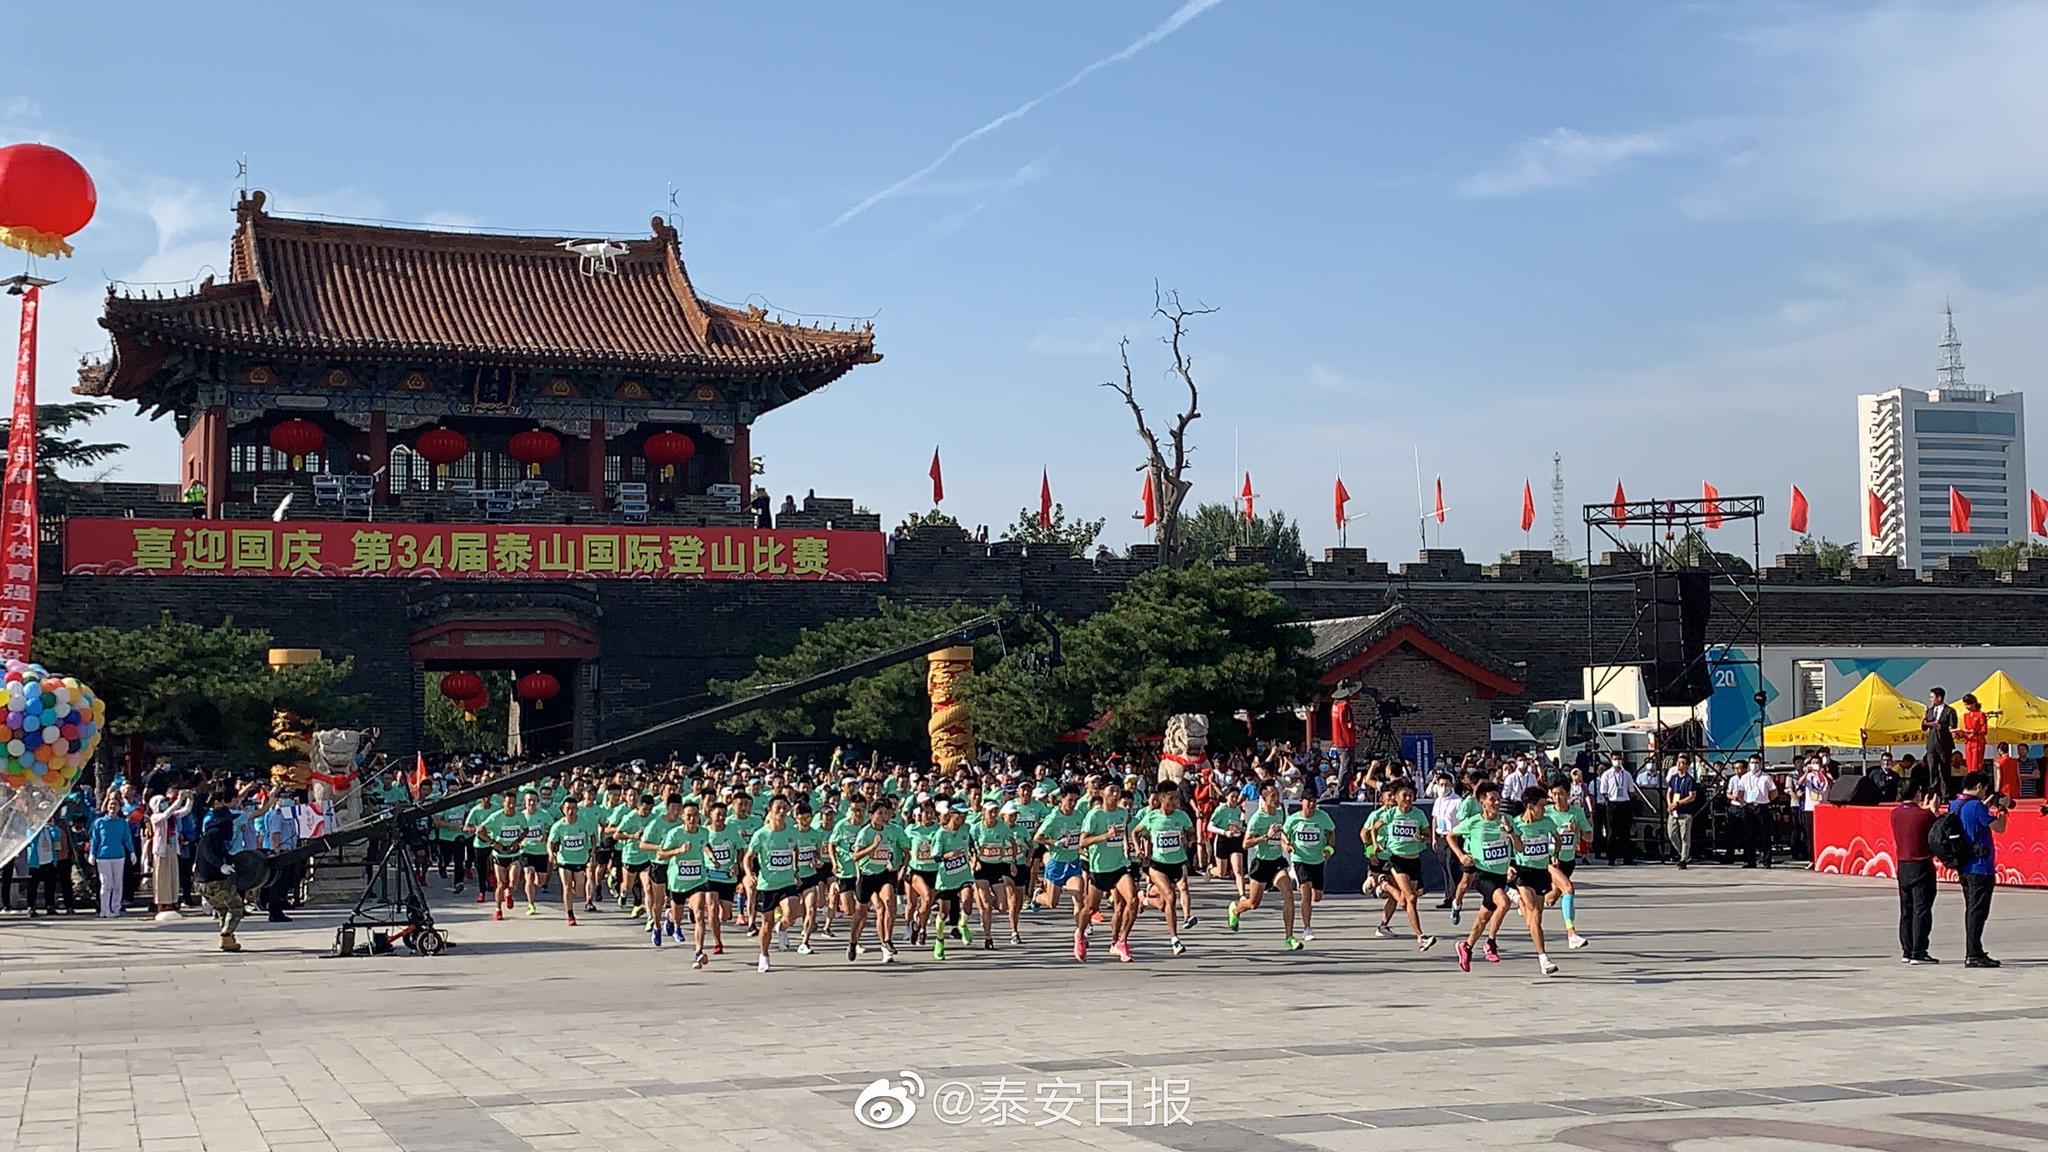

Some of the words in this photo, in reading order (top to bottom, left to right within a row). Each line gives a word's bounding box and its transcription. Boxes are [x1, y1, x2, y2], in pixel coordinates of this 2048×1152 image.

[132, 528, 323, 570] 喜迎国庆
[350, 530, 830, 576] 第34届泰山国际登山比赛
[714, 850, 730, 859] 015
[1485, 848, 1507, 859] 0021
[1524, 845, 1547, 855] 0003
